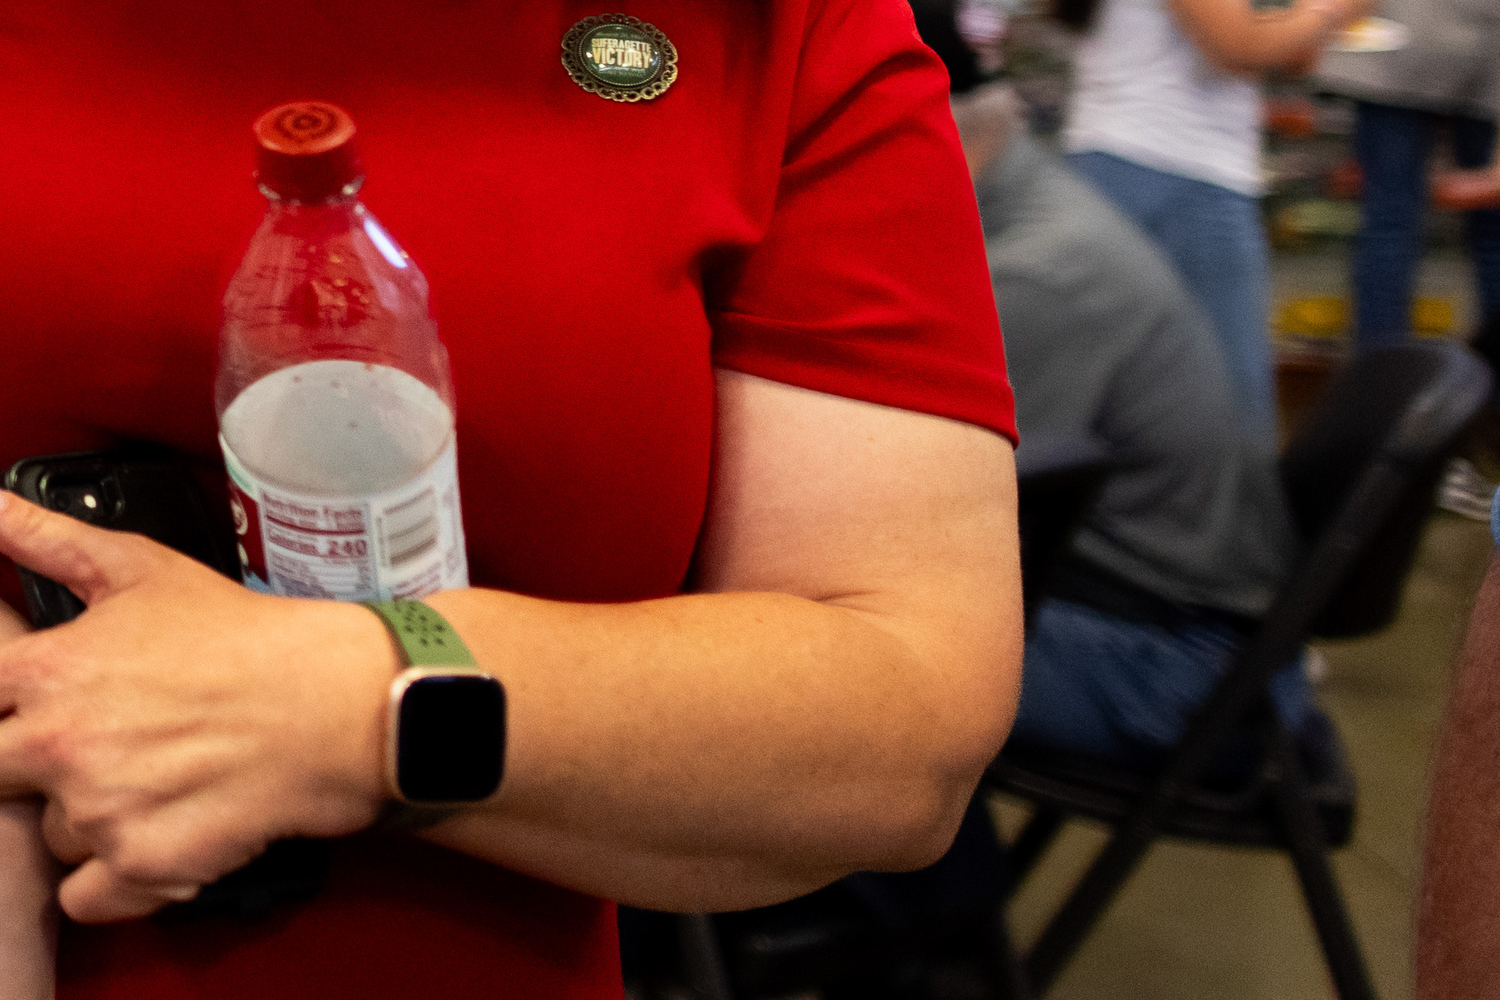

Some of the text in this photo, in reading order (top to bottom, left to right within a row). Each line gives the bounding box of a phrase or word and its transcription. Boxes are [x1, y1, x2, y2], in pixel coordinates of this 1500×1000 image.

[592, 38, 652, 53] SUFFRAGETTE
[592, 47, 651, 69] VICTORY
[328, 539, 367, 557] 240
